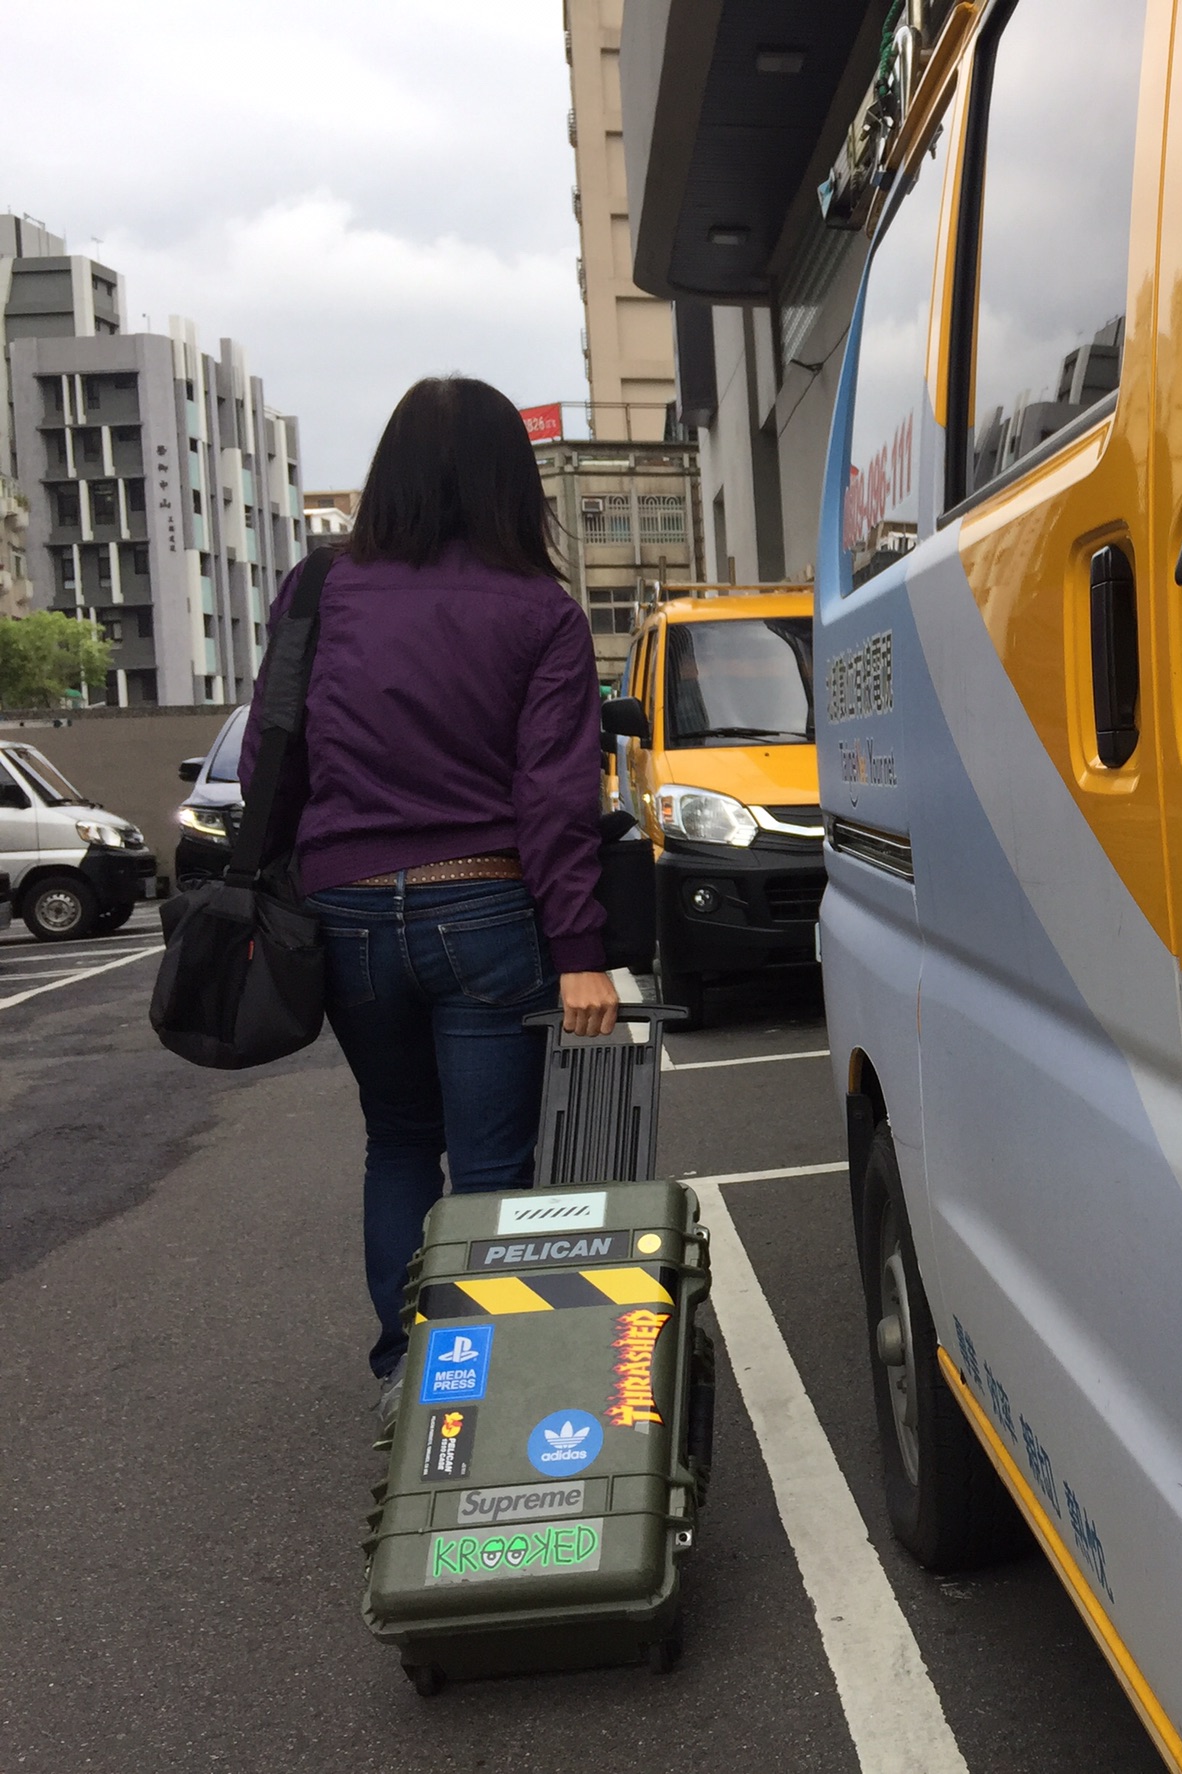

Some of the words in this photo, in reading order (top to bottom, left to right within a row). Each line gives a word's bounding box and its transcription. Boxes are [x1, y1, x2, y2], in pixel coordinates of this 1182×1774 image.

[484, 1237, 613, 1265] PELICAN
[435, 1369, 477, 1381] MEDIA
[604, 1309, 672, 1428] THRASHER
[433, 1378, 477, 1392] PRESS
[541, 1449, 587, 1462] adidas
[461, 1488, 582, 1521] Supreme
[433, 1525, 597, 1578] KROOKED
